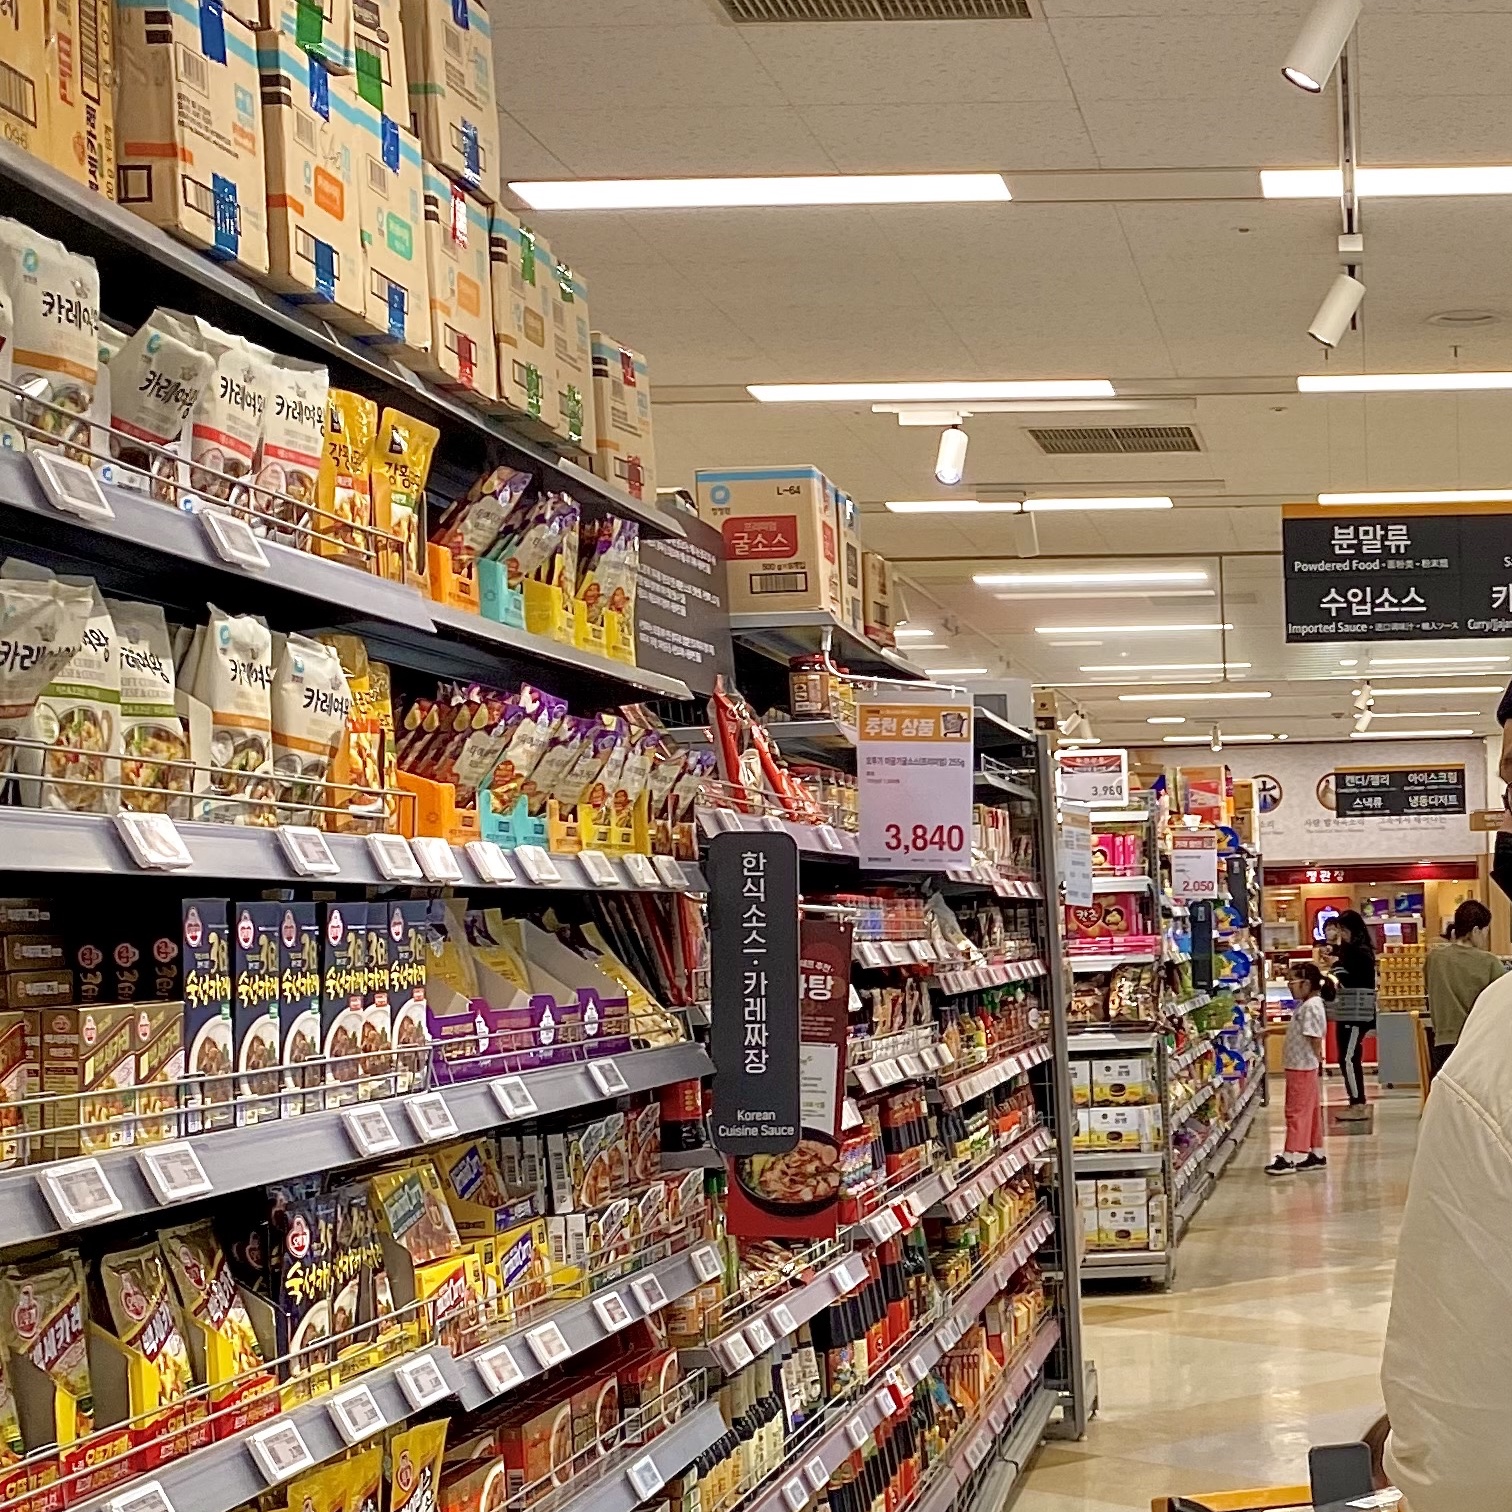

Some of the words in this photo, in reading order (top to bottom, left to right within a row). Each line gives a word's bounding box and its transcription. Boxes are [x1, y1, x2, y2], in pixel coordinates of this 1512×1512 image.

[731, 532, 790, 556] 굴소스
[1331, 524, 1412, 555] 분말류
[1294, 560, 1349, 572] Powdered
[1352, 558, 1380, 570] Food
[1320, 586, 1427, 617] 수입소스
[1288, 622, 1336, 636] Imported
[1337, 622, 1368, 633] Sauce
[901, 718, 935, 738] 상품
[1407, 771, 1457, 784] 아이스크림
[885, 824, 964, 854] 3,840
[737, 1109, 776, 1122] Korean
[718, 1124, 759, 1137] Cuisine
[760, 1123, 795, 1136] Sauce
